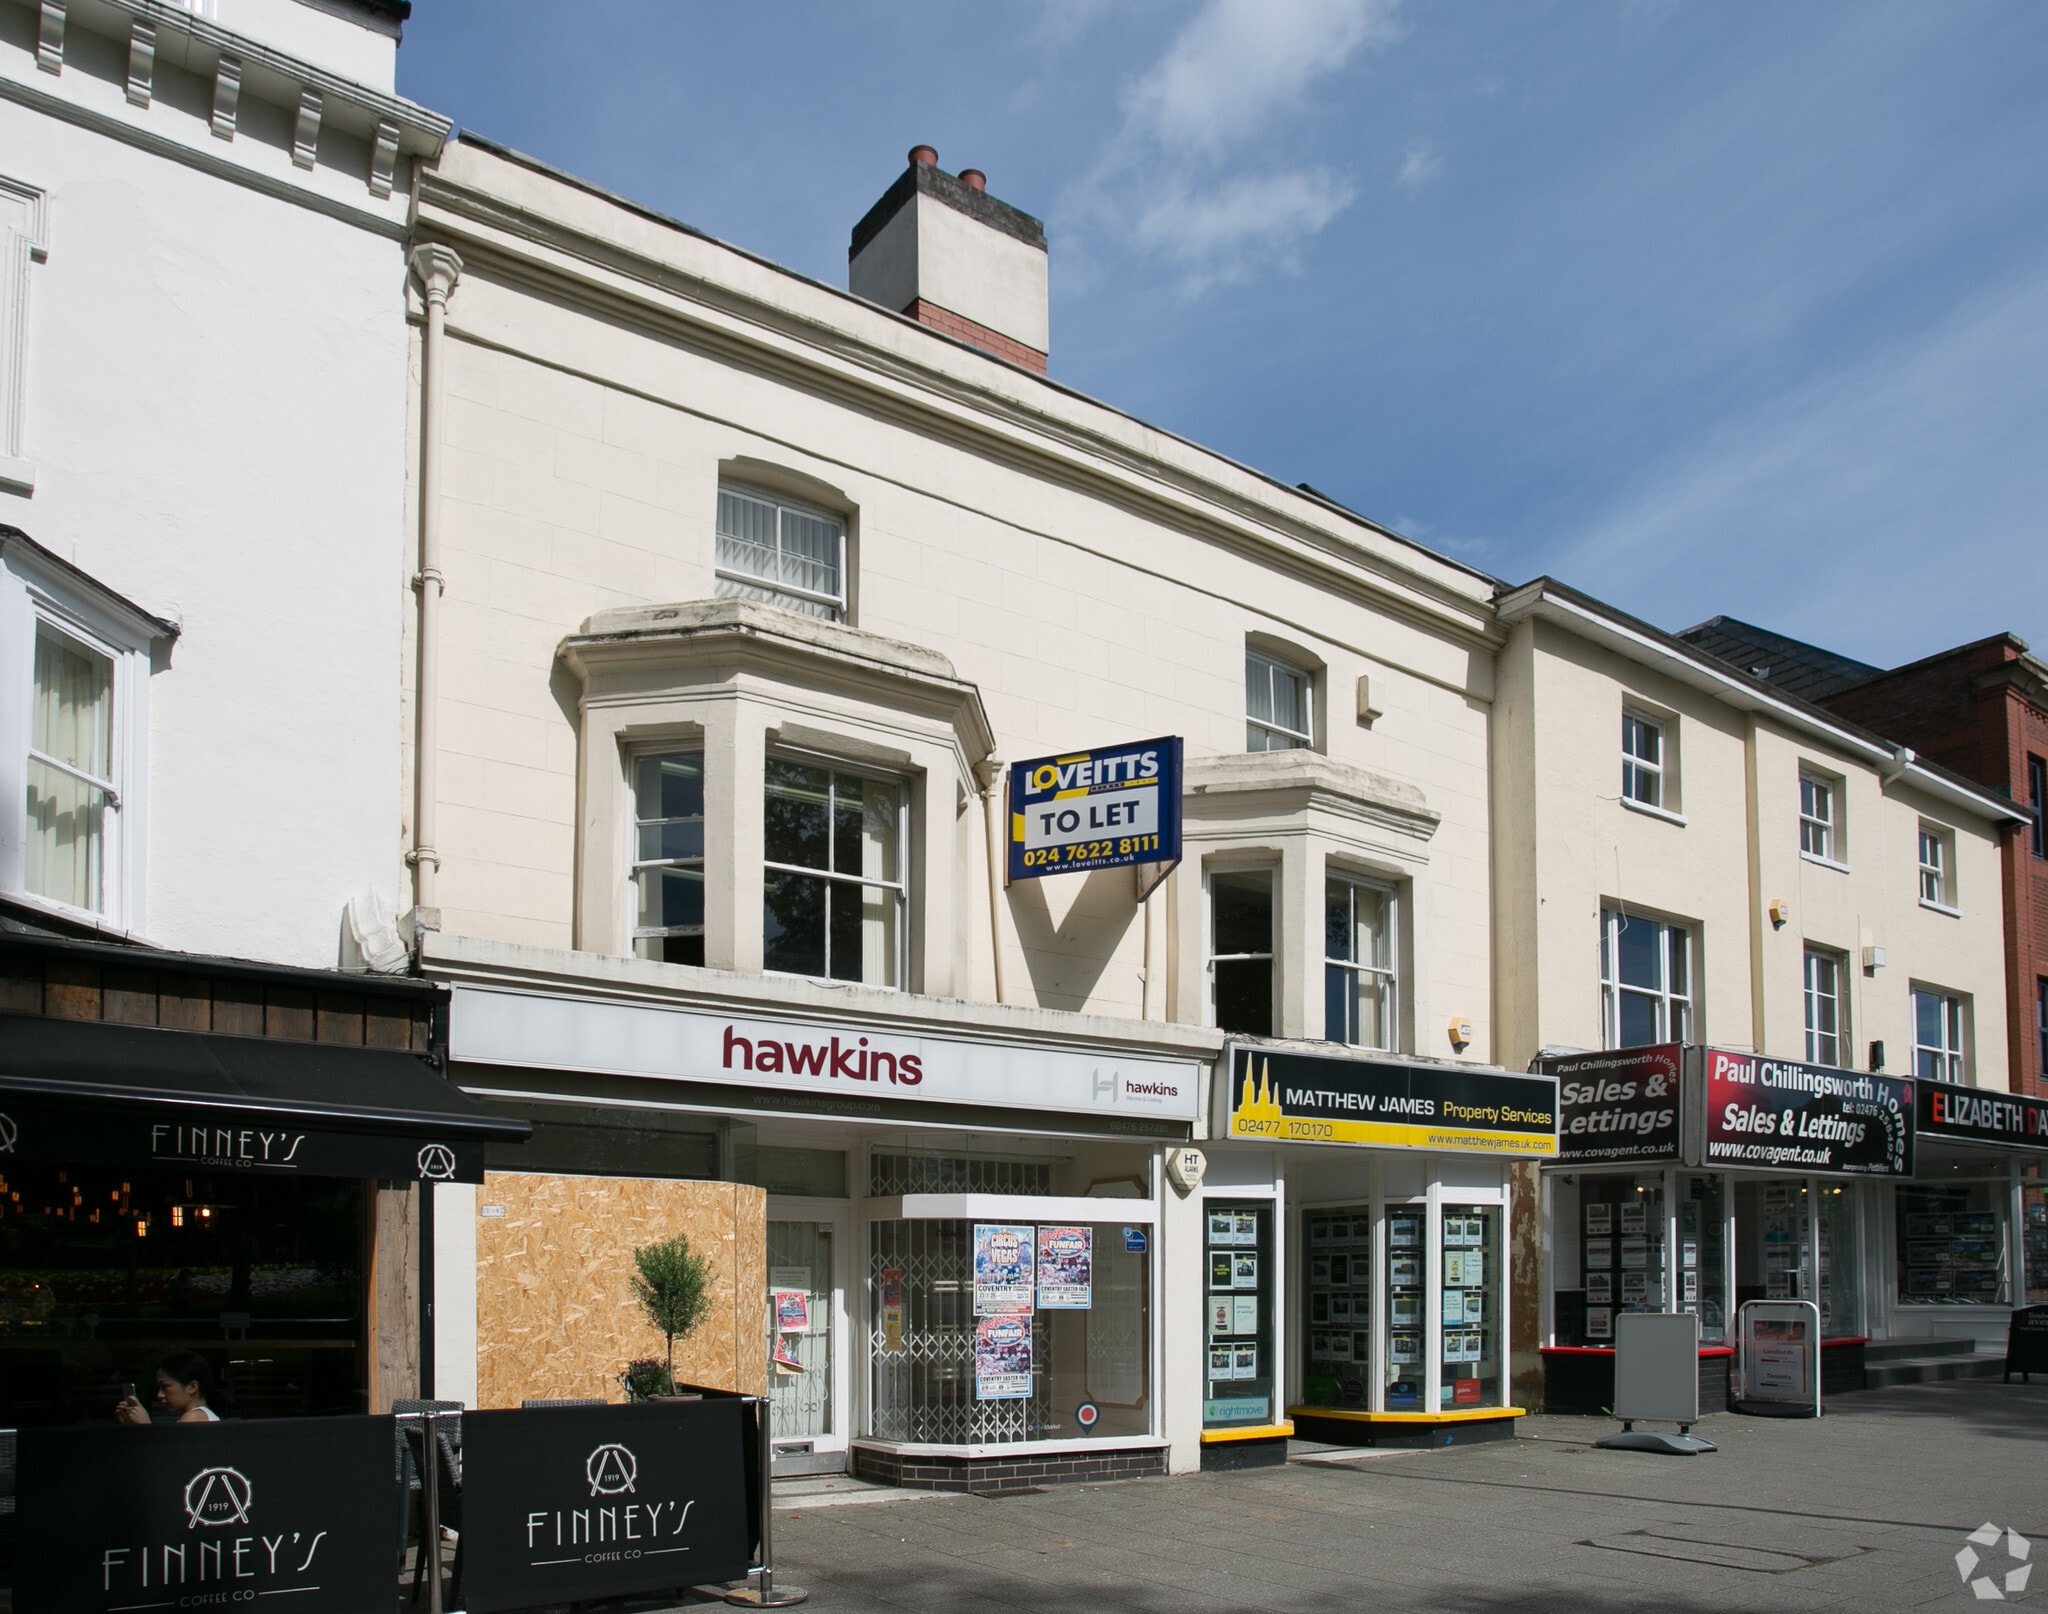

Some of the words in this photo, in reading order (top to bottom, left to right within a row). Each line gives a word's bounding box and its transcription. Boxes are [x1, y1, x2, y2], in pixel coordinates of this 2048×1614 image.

[1024, 751, 1159, 796] LOVEITTS
[1040, 809, 1080, 836] TO
[1090, 800, 1140, 829] LET
[1024, 848, 1060, 866] 024
[1066, 840, 1113, 861] 7622
[1119, 834, 1159, 854] 8111
[1045, 853, 1135, 872] www.loveitts.co.uk
[723, 1025, 923, 1086] hawkins
[1557, 1062, 1578, 1073] Paul
[1580, 1055, 1653, 1071] Chillingsworth
[1654, 1053, 1676, 1084] Homes
[1126, 1080, 1178, 1097] hawkins
[1560, 1079, 1637, 1106] Sales
[1644, 1073, 1668, 1098] &
[1286, 1088, 1376, 1112] MATTHEW
[1379, 1096, 1435, 1116] JAMES
[1443, 1101, 1499, 1125] Property
[1501, 1106, 1552, 1125] Services
[1714, 1055, 1756, 1084] Paul
[1760, 1062, 1874, 1100] Chillingsworth
[1876, 1082, 1906, 1173] Homes
[1843, 1101, 1854, 1114] tel:
[1855, 1103, 1878, 1117] 02476
[1933, 1092, 2022, 1133] ELIZABETH
[1110, 1121, 1137, 1131] 02476
[1238, 1119, 1281, 1134] 02477
[1288, 1121, 1333, 1137] 170170
[1722, 1102, 1777, 1134] Sales
[1779, 1109, 1794, 1137] &
[1798, 1111, 1866, 1148] Lettings
[151, 1124, 305, 1161] FINNEY'S
[1428, 1134, 1551, 1150] www.matthewjames.uk.com
[200, 1156, 232, 1167] COFFEE
[235, 1159, 252, 1167] CO
[1184, 1153, 1198, 1165] HT
[1709, 1141, 1832, 1165] www.covagent.co.uk
[991, 1234, 1018, 1248] CIRCUS
[1048, 1240, 1083, 1250] FUNFAIR
[991, 1248, 1018, 1264] VEGAS
[987, 1329, 1022, 1339] FUNFAIR
[1219, 1406, 1264, 1418] rightmove
[602, 1474, 620, 1482] 1919
[208, 1502, 229, 1512] 1919
[527, 1500, 695, 1548] FINNEY'S
[102, 1531, 327, 1591] FINNEY'S
[585, 1552, 621, 1563] COFFEE
[624, 1550, 641, 1559] CO
[180, 1593, 228, 1607] COFFEE
[232, 1590, 255, 1601] CO
